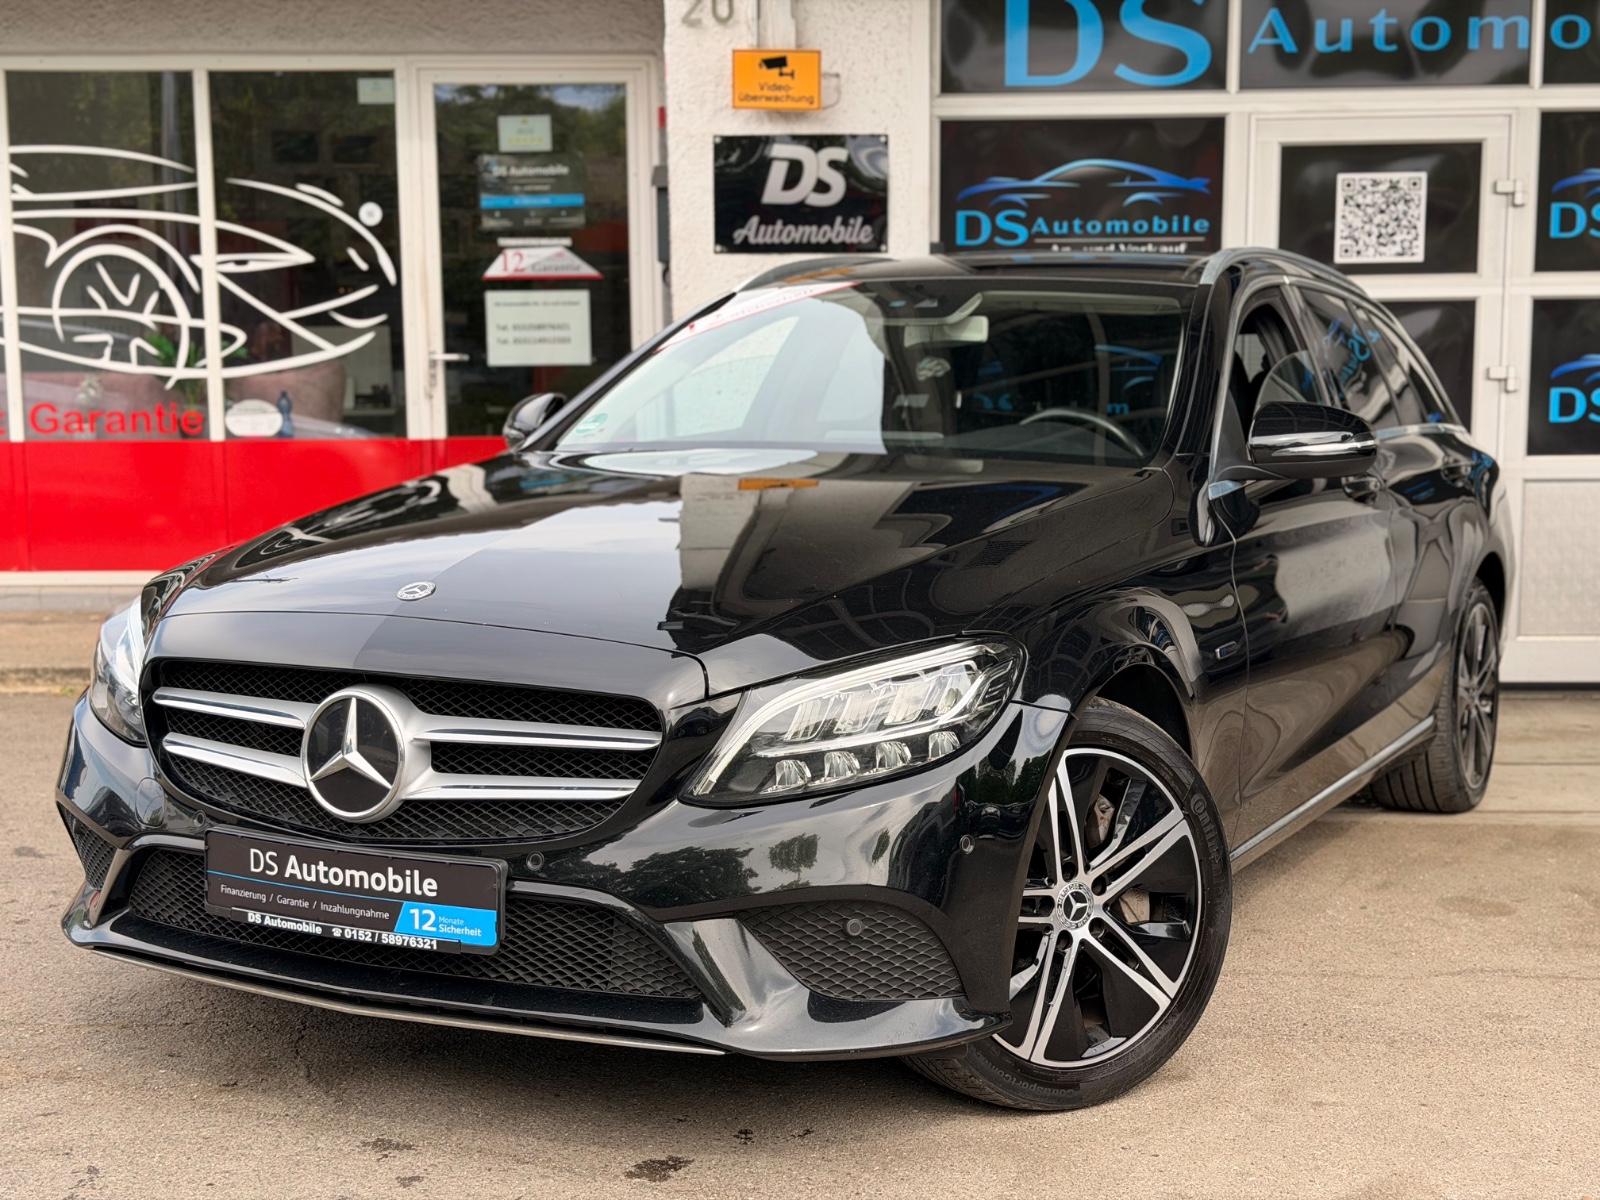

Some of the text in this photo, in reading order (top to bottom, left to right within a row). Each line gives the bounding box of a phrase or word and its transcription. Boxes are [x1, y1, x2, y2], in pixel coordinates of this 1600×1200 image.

[1004, 0, 1212, 87] DS
[760, 143, 849, 207] DS
[732, 214, 873, 245] Automobile
[955, 209, 1211, 247] DS Automobile
[29, 402, 204, 435] Garantie
[249, 848, 438, 897] DS Automobile
[220, 884, 267, 903] Finanzierung
[276, 894, 310, 909] Garantie
[320, 902, 390, 920] Inzahlungnahme
[247, 912, 323, 935] DS Automobile
[409, 907, 465, 932] 12 Monate
[438, 924, 482, 937] Sicherheit
[344, 928, 372, 942] 0152
[381, 932, 438, 950] 58976321
